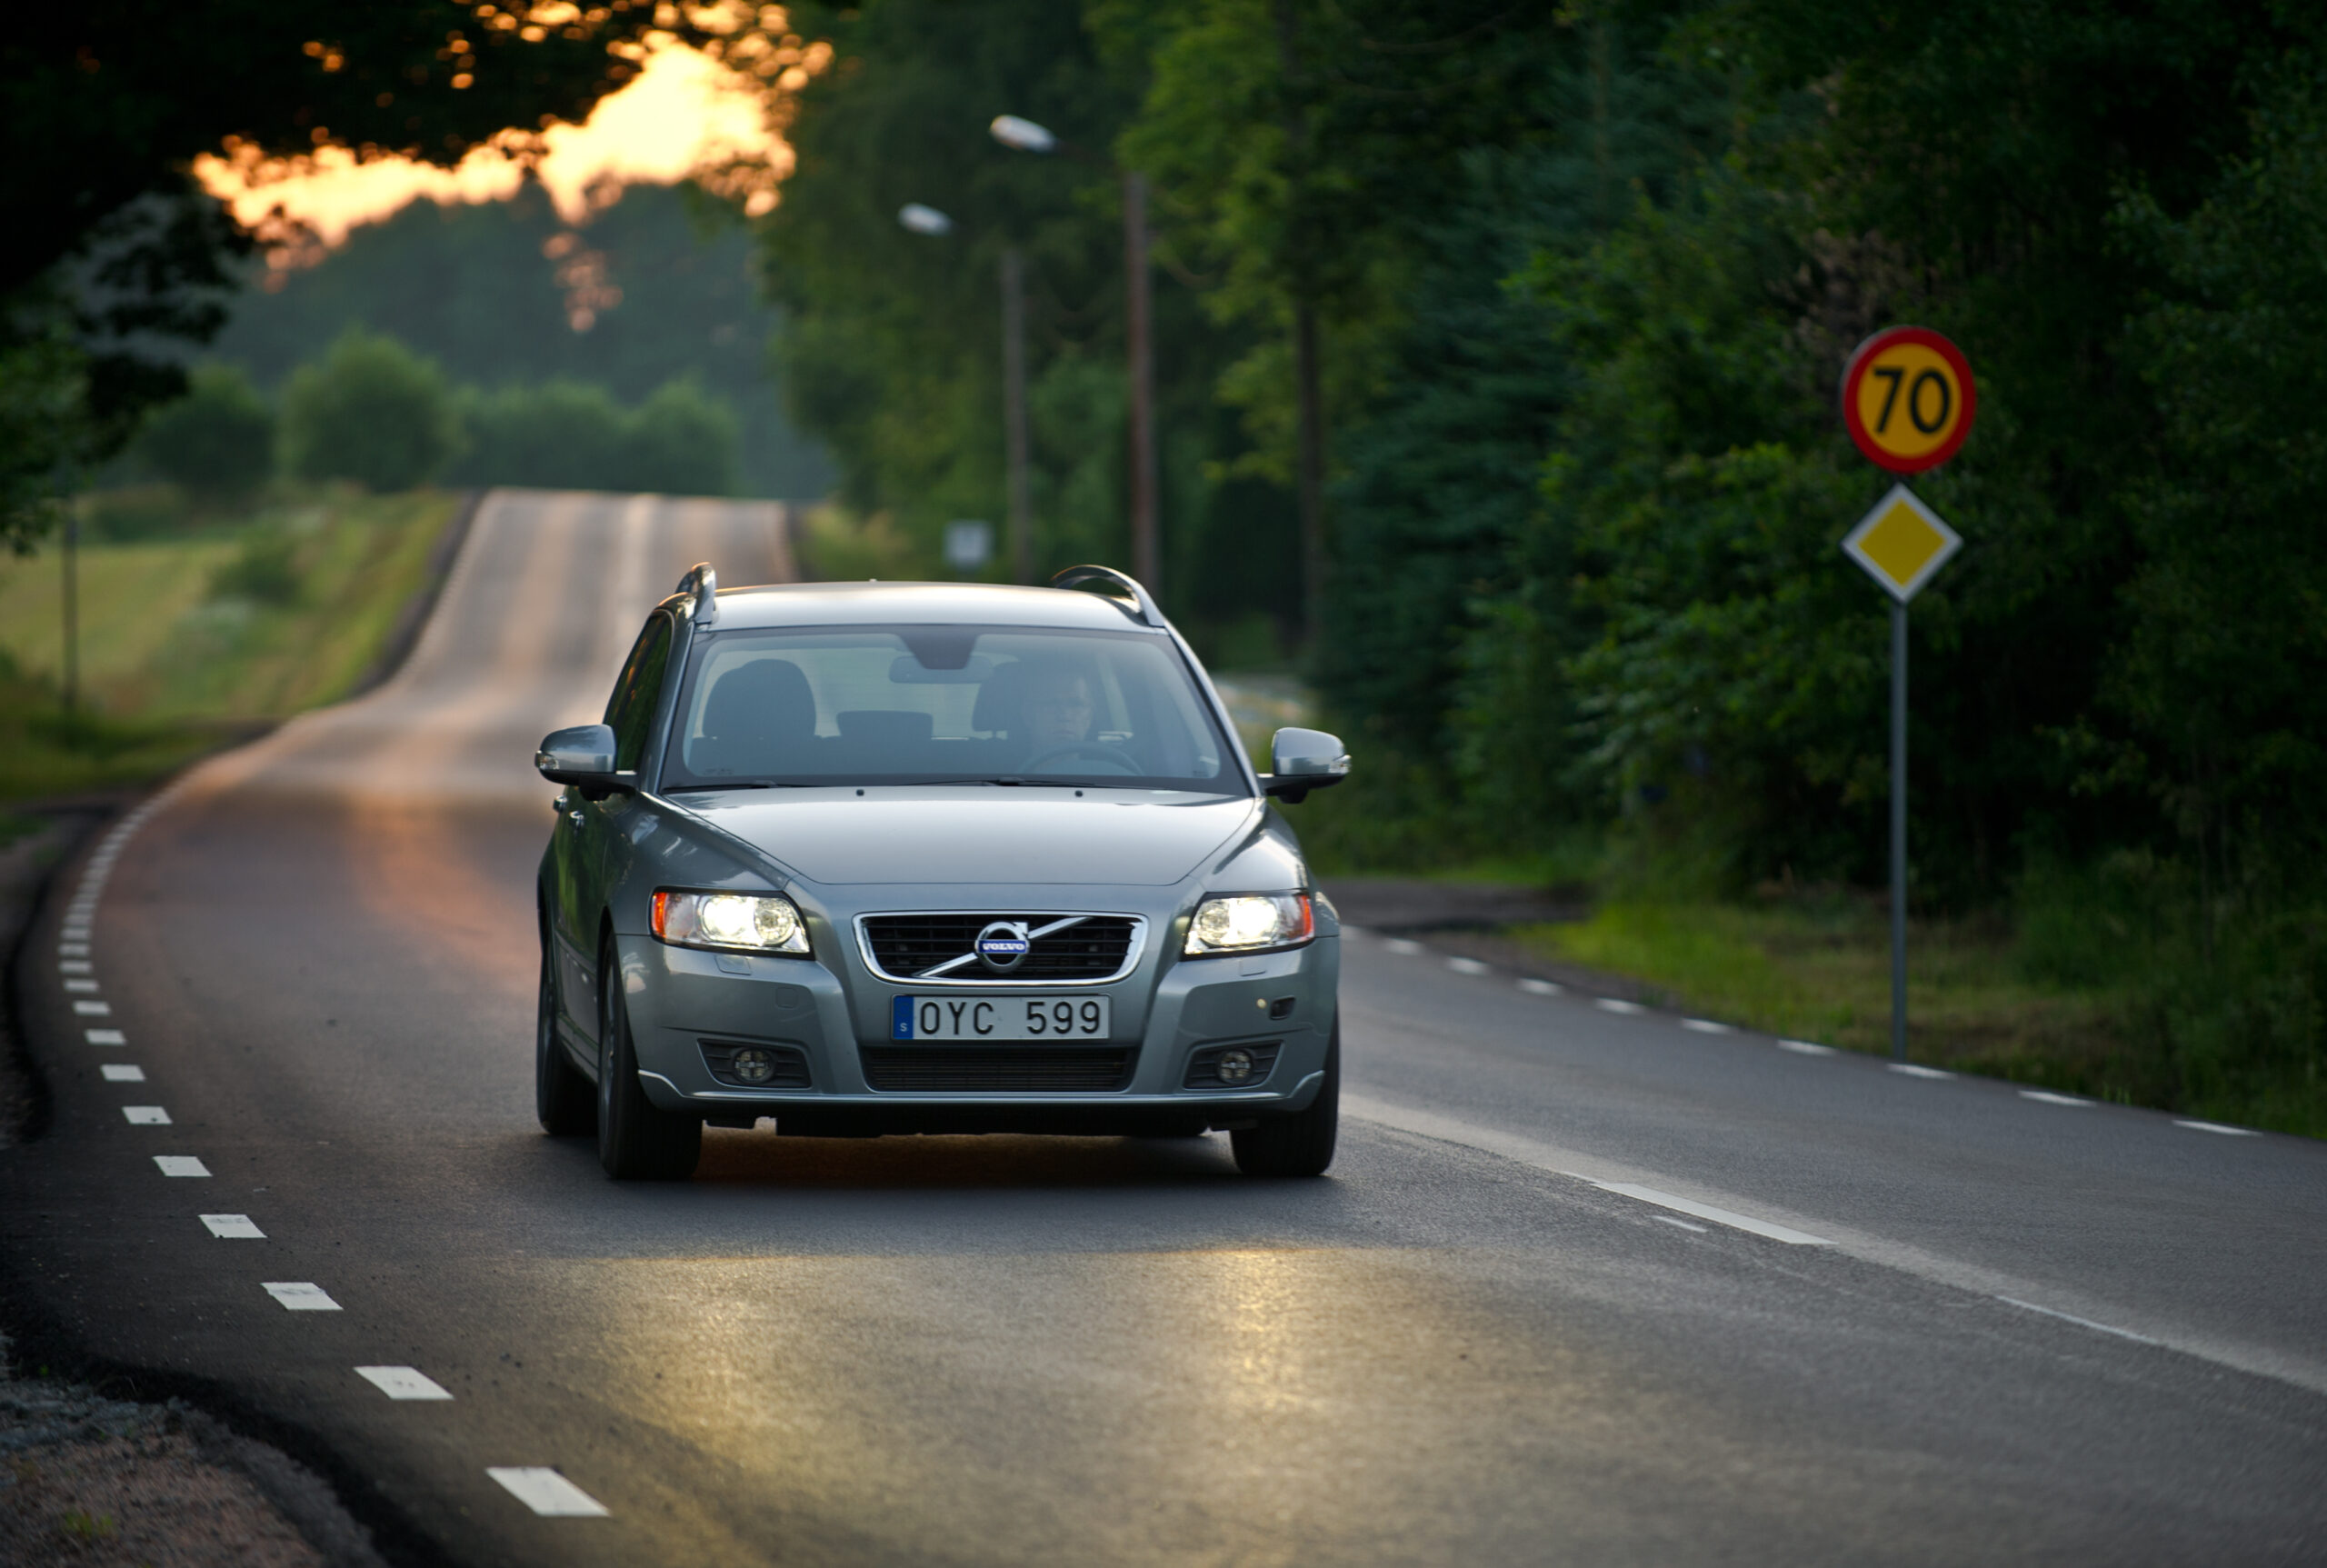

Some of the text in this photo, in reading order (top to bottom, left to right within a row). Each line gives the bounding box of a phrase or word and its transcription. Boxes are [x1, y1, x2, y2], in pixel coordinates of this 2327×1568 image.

[1873, 367, 1952, 435] 70
[982, 943, 1026, 951] VOLVO
[900, 1023, 908, 1033] S
[920, 1001, 1100, 1035] OYC 599
